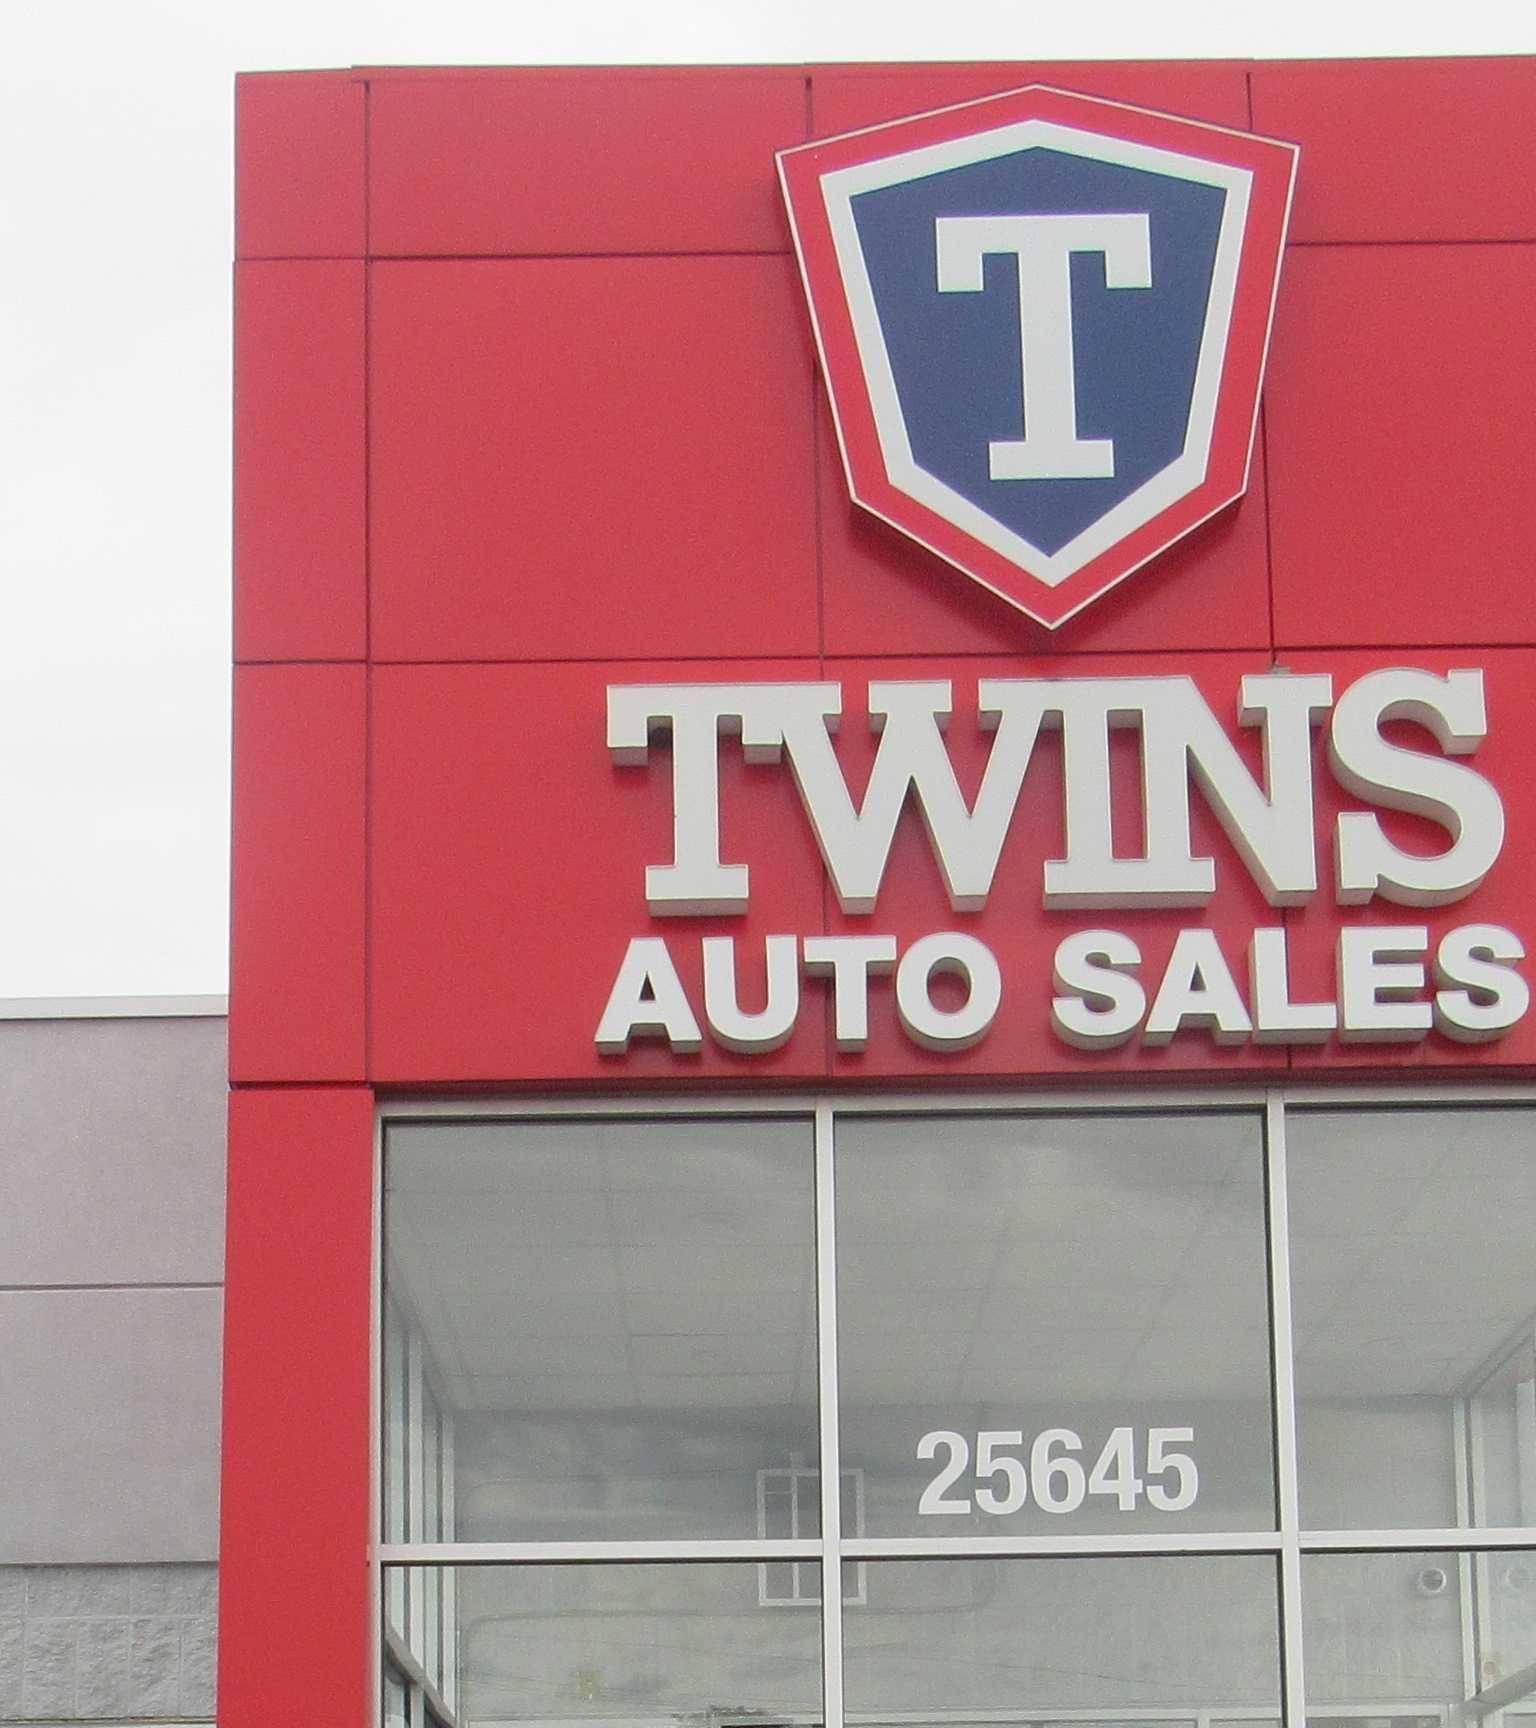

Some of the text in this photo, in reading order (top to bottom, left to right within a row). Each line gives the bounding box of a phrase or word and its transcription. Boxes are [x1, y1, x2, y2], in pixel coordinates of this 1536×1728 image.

[934, 212, 1152, 481] T
[606, 666, 1505, 915] TWINS
[594, 925, 1530, 1054] AUTO SALES
[916, 1427, 1199, 1516] 25645
